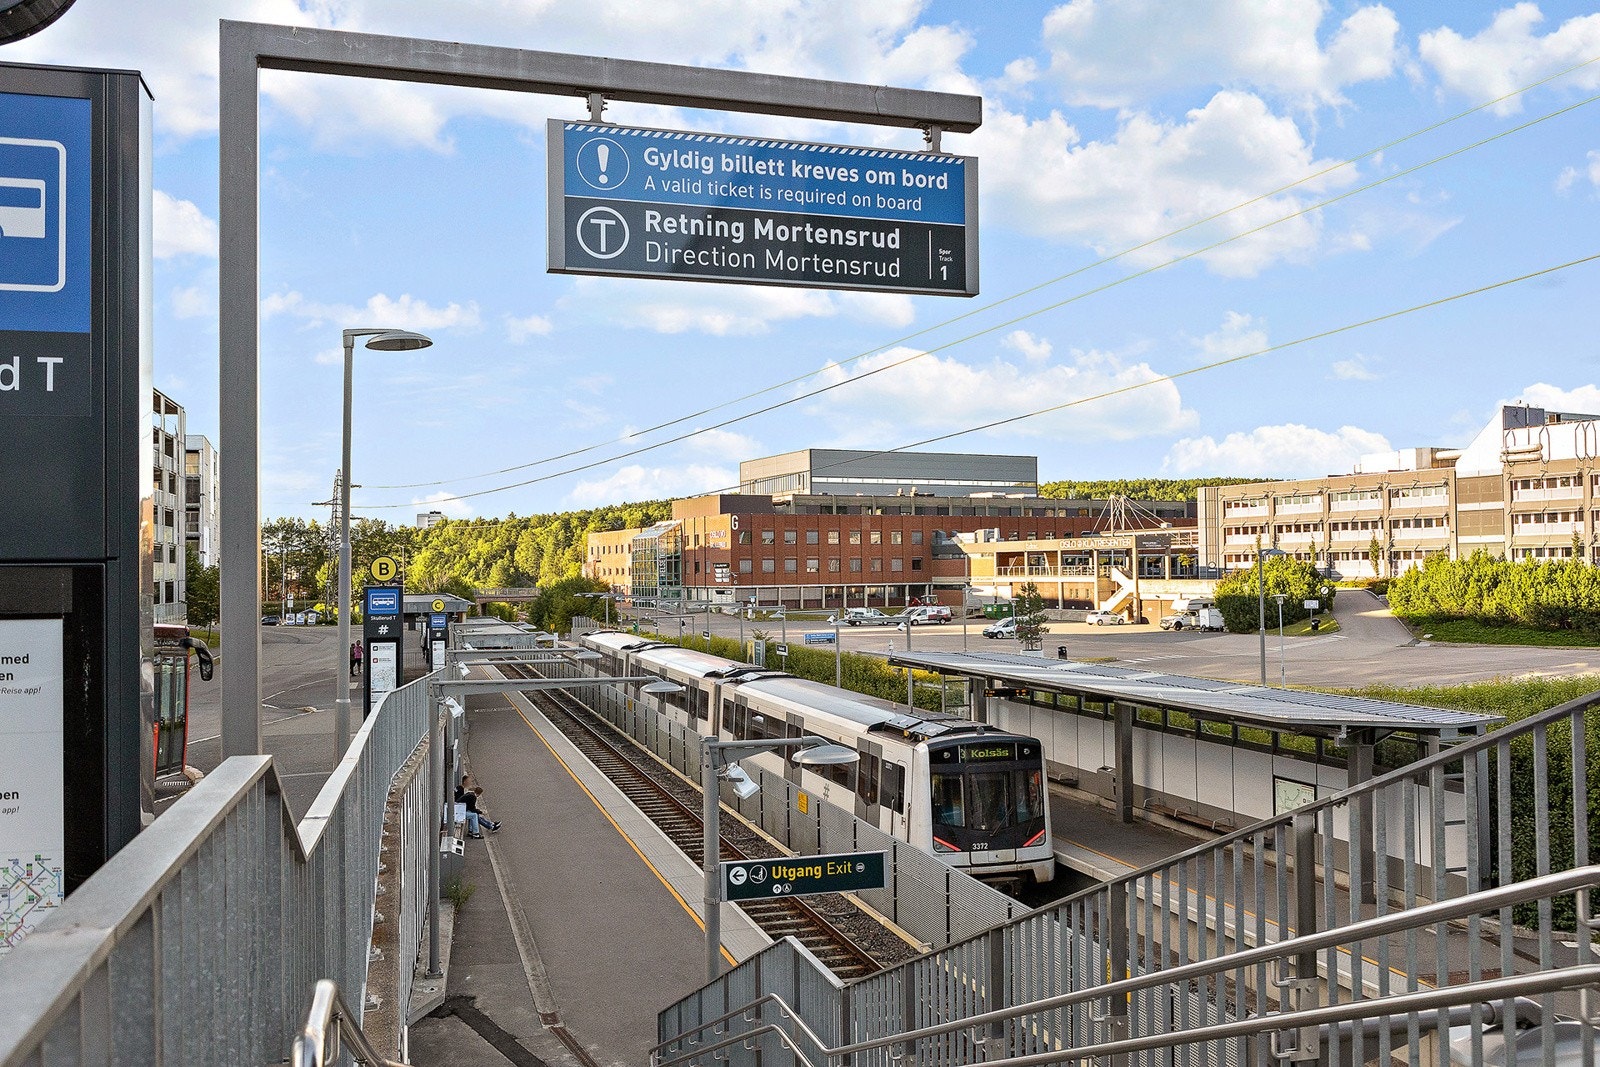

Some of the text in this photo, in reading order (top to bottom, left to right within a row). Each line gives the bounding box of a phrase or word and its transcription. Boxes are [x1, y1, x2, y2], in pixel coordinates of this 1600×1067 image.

[643, 146, 949, 190] Gyldig billett kreves om bord
[644, 175, 922, 212] A valid ticket is required on board
[645, 210, 900, 249] Retning Mortensrud
[646, 242, 900, 278] Direction Mortensrud
[940, 265, 947, 281] 1
[37, 357, 64, 391] T
[731, 515, 739, 530] G
[1059, 541, 1077, 549] OSLO
[379, 562, 390, 576] B
[1, 653, 30, 665] med
[23, 686, 42, 695] app!
[2, 805, 20, 815] app!
[972, 842, 989, 850] 3372
[771, 860, 852, 881] Utgang Exit
